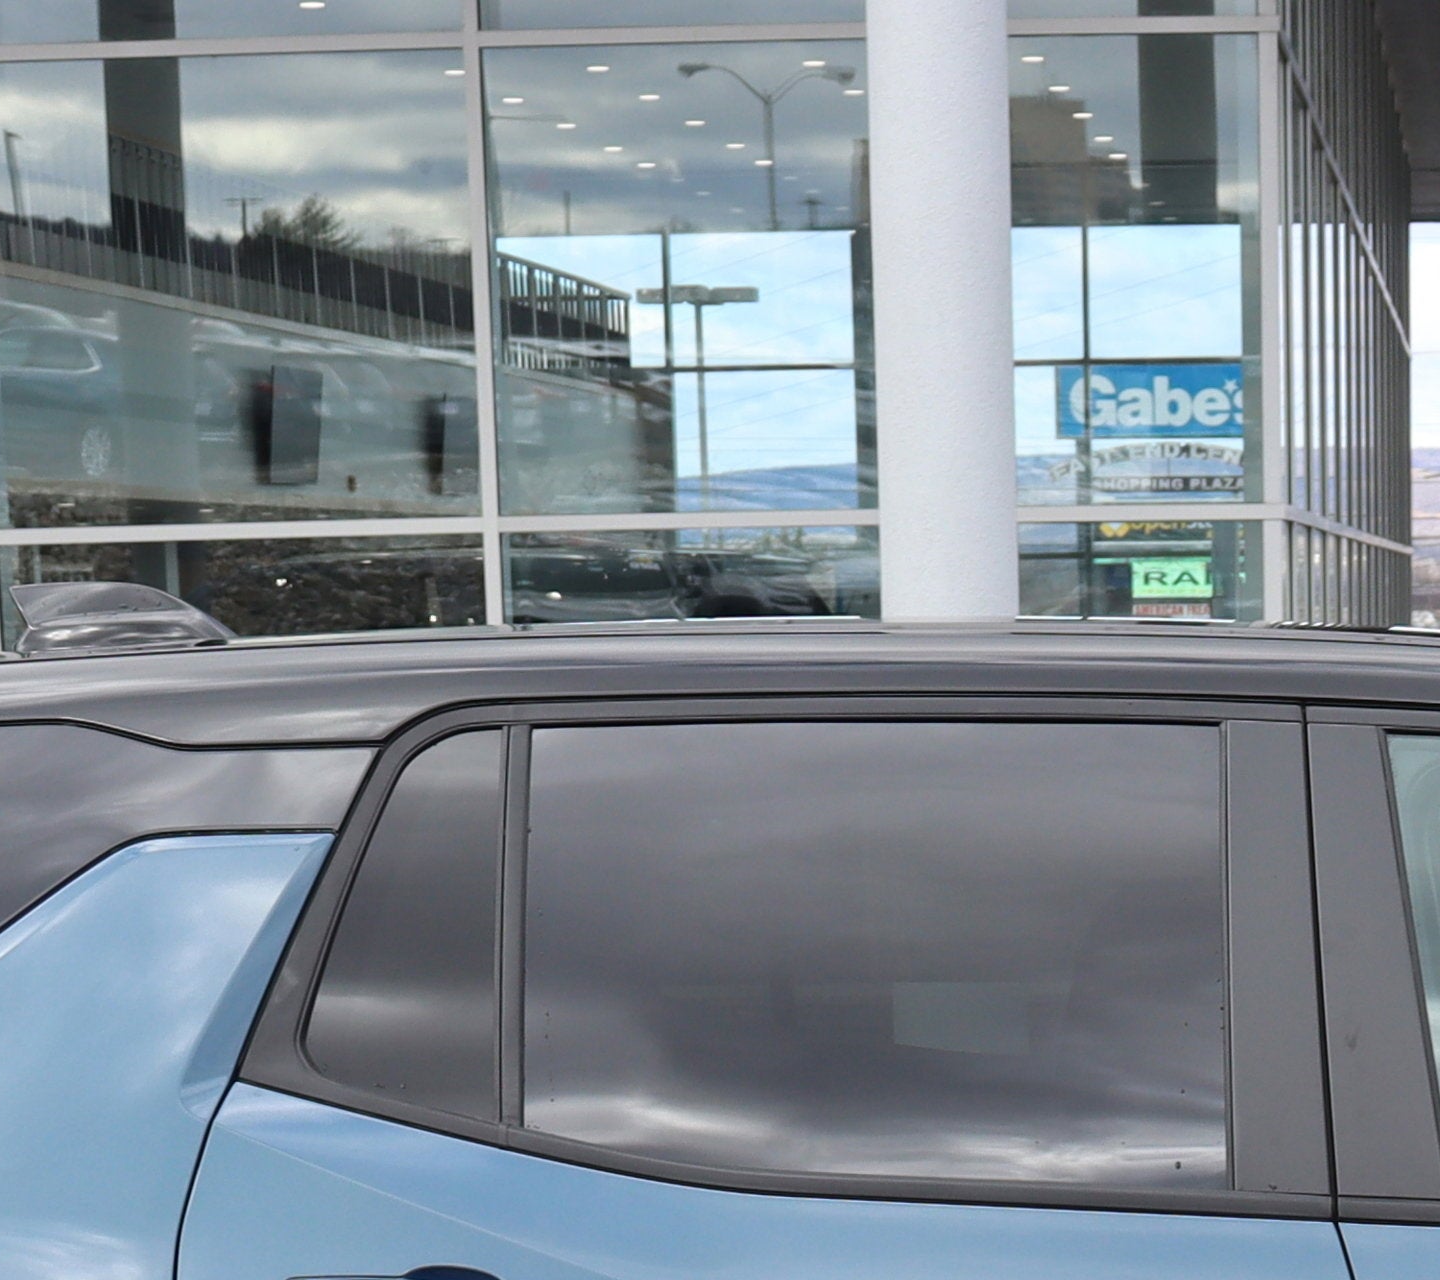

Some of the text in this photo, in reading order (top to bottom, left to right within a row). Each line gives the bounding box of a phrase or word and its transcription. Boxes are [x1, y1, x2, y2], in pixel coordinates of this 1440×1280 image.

[1128, 442, 1181, 460] END
[1185, 443, 1244, 467] CEN
[1092, 477, 1184, 491] SHOPPING
